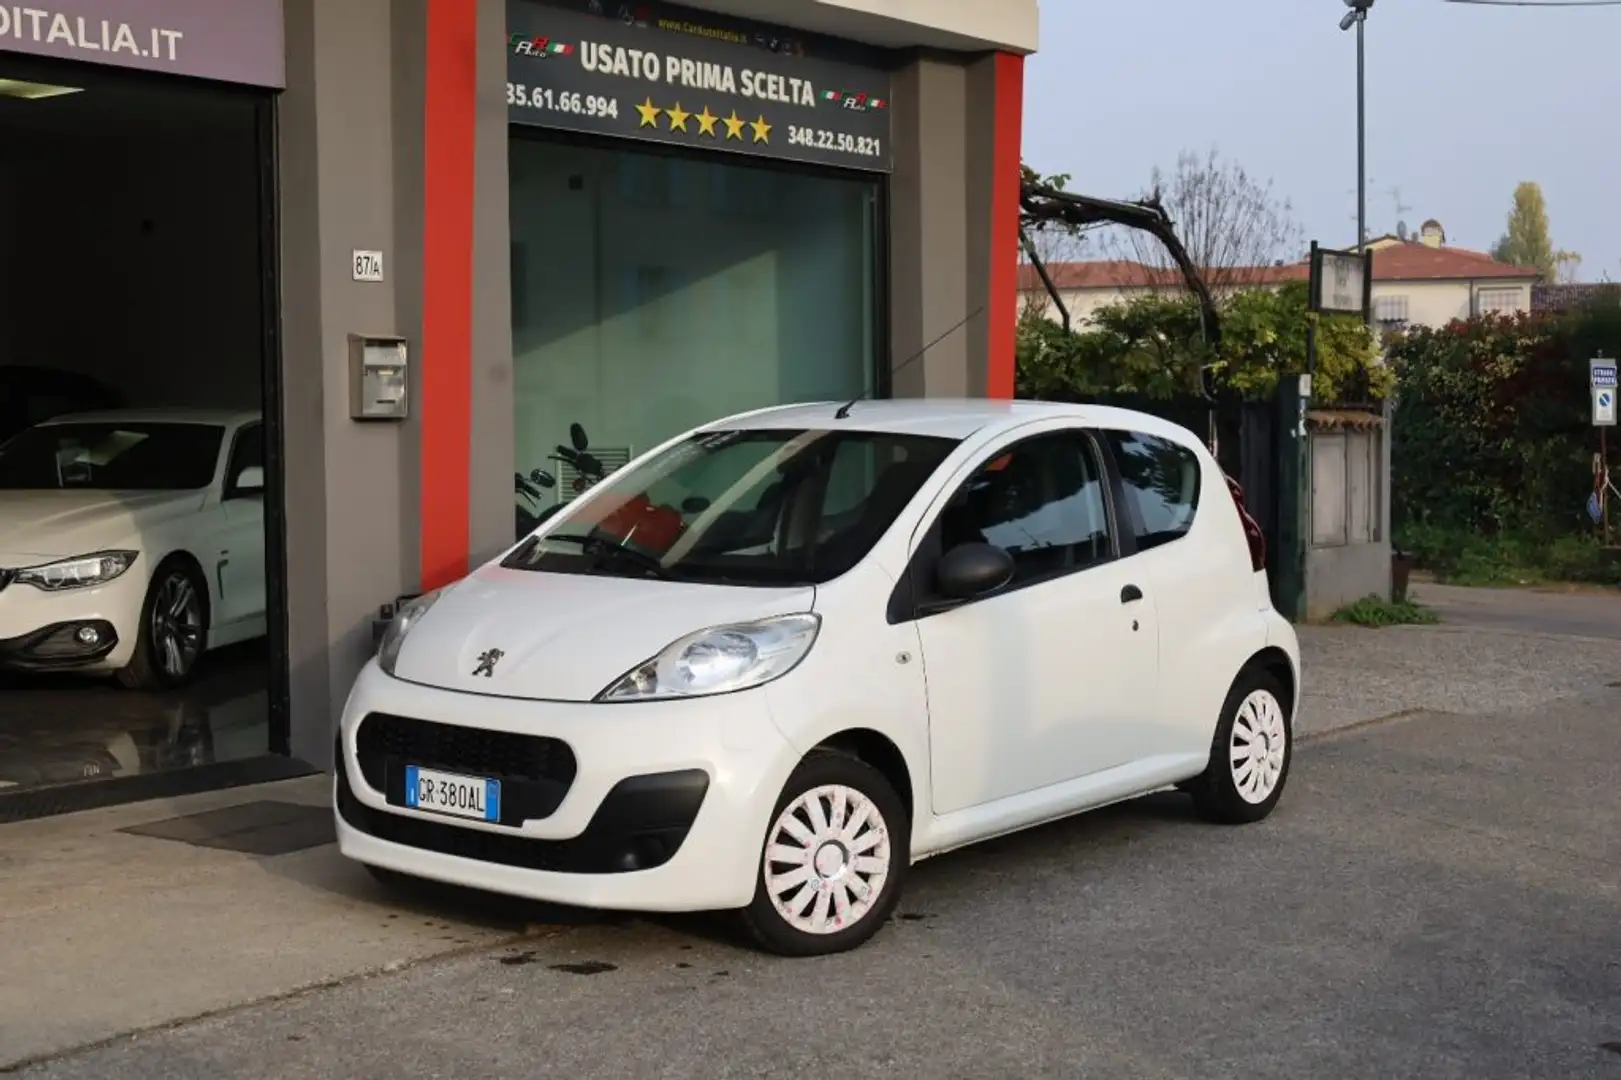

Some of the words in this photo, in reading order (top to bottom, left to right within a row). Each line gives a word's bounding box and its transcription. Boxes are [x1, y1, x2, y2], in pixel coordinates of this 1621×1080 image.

[580, 40, 661, 82] USATO
[666, 56, 736, 95] PRIMA
[740, 68, 816, 109] SCELTA
[788, 125, 880, 156] 348.22.50.821
[356, 256, 380, 275] 87/A
